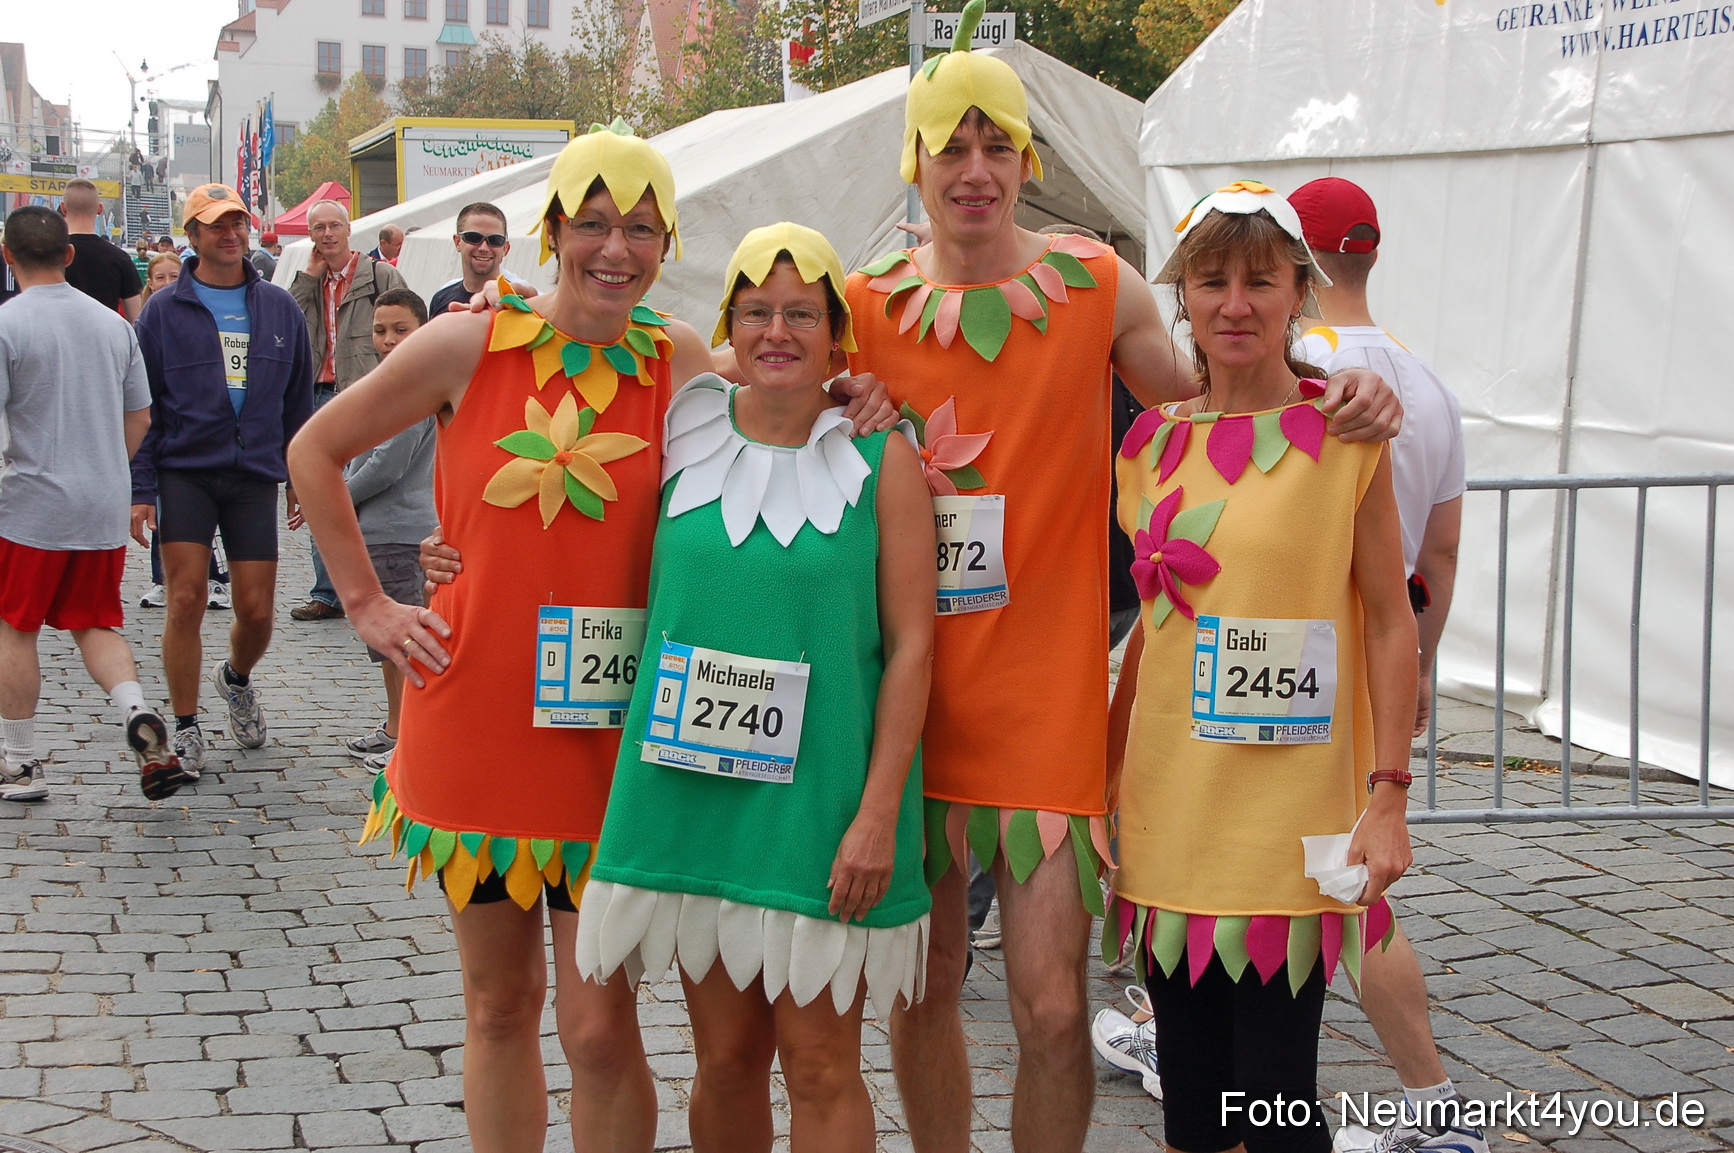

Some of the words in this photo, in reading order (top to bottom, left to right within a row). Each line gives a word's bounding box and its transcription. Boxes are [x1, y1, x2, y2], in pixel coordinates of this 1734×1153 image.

[937, 541, 987, 572] 872
[952, 591, 1007, 607] PFLEIDERER
[581, 618, 623, 640] Erika
[1226, 628, 1267, 651] Gabi
[547, 651, 556, 667] D
[581, 654, 641, 685] 246
[697, 659, 775, 692] Michaela
[1199, 661, 1206, 677] C
[1225, 666, 1320, 699] 2454
[661, 687, 671, 704] D
[550, 712, 589, 721] BOCK
[691, 696, 783, 738] 2740
[1276, 724, 1329, 736] PFLEIDERER
[659, 749, 697, 763] BOCK
[735, 759, 791, 775] PFLEIDERER
